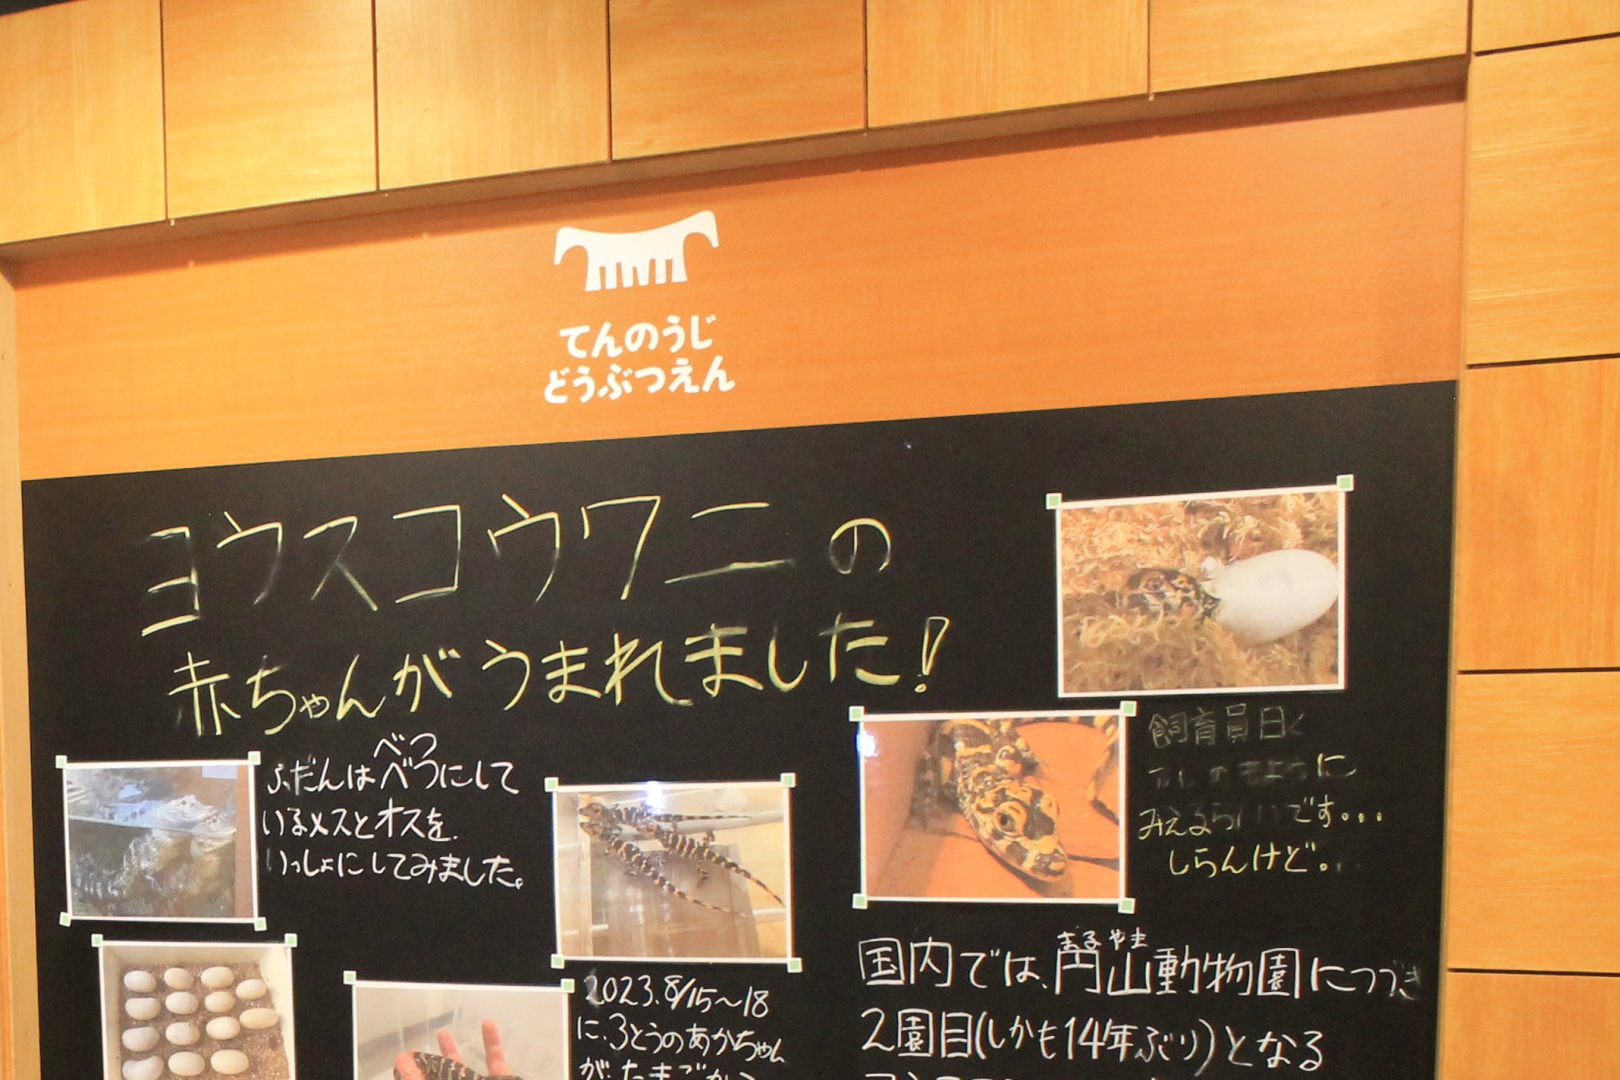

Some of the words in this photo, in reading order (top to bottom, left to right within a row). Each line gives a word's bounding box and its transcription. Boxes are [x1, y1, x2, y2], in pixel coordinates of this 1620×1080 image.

[559, 314, 716, 359] てんのうじ
[542, 354, 735, 405] どうぶつえん
